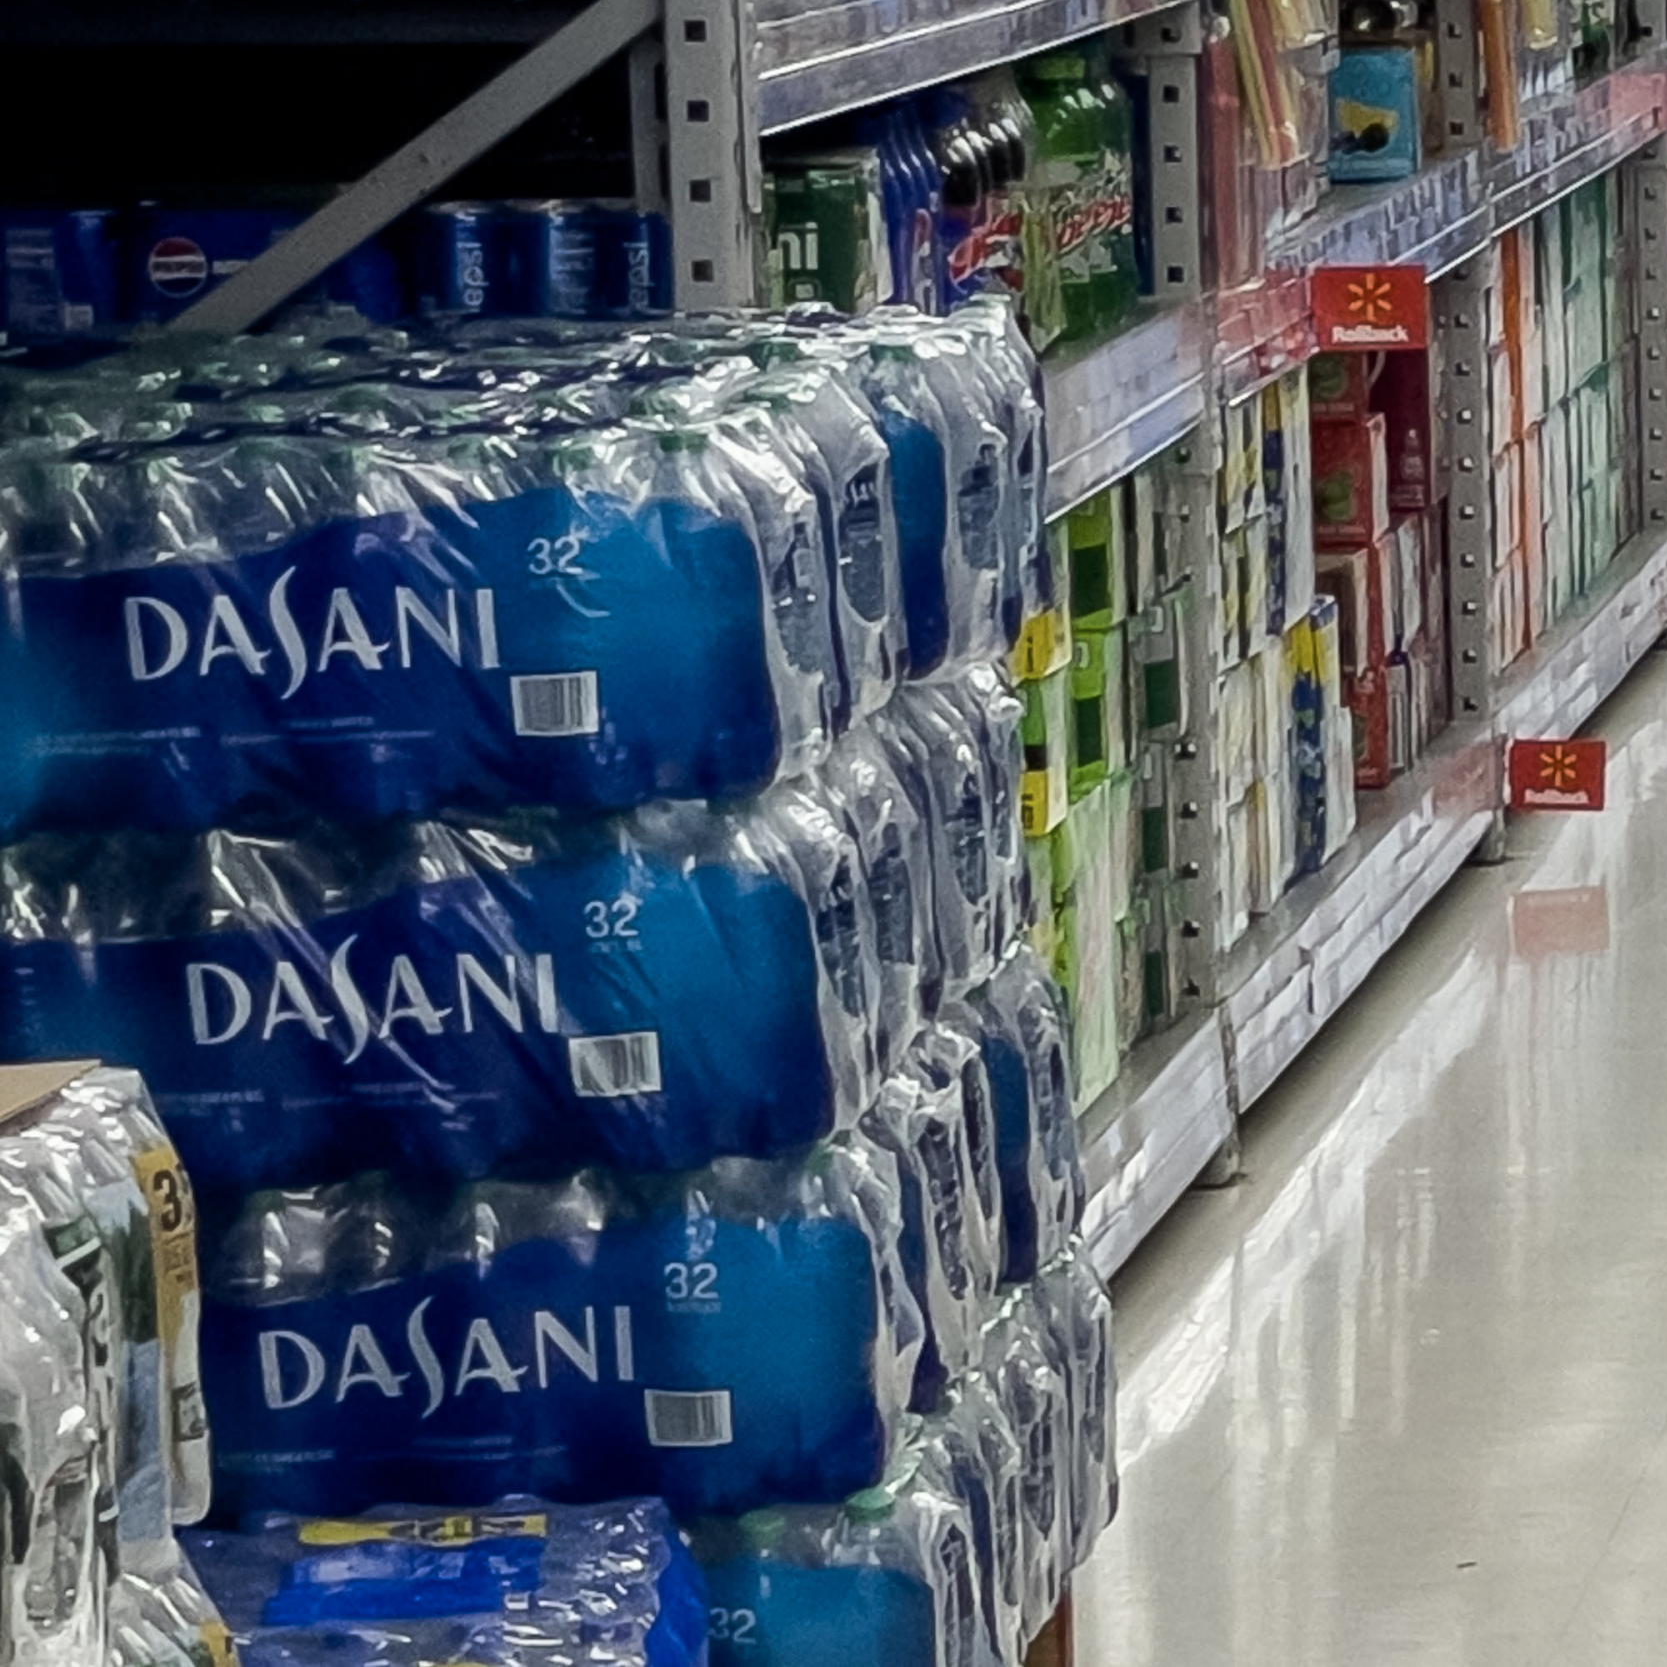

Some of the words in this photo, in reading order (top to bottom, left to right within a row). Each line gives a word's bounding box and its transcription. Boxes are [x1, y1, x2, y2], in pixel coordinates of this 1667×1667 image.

[527, 537, 583, 576] 32
[124, 565, 501, 700] DASANI
[583, 900, 639, 939] 32
[185, 935, 560, 1065] DASANI
[663, 1263, 719, 1300] 32
[258, 1295, 635, 1419] DASANI
